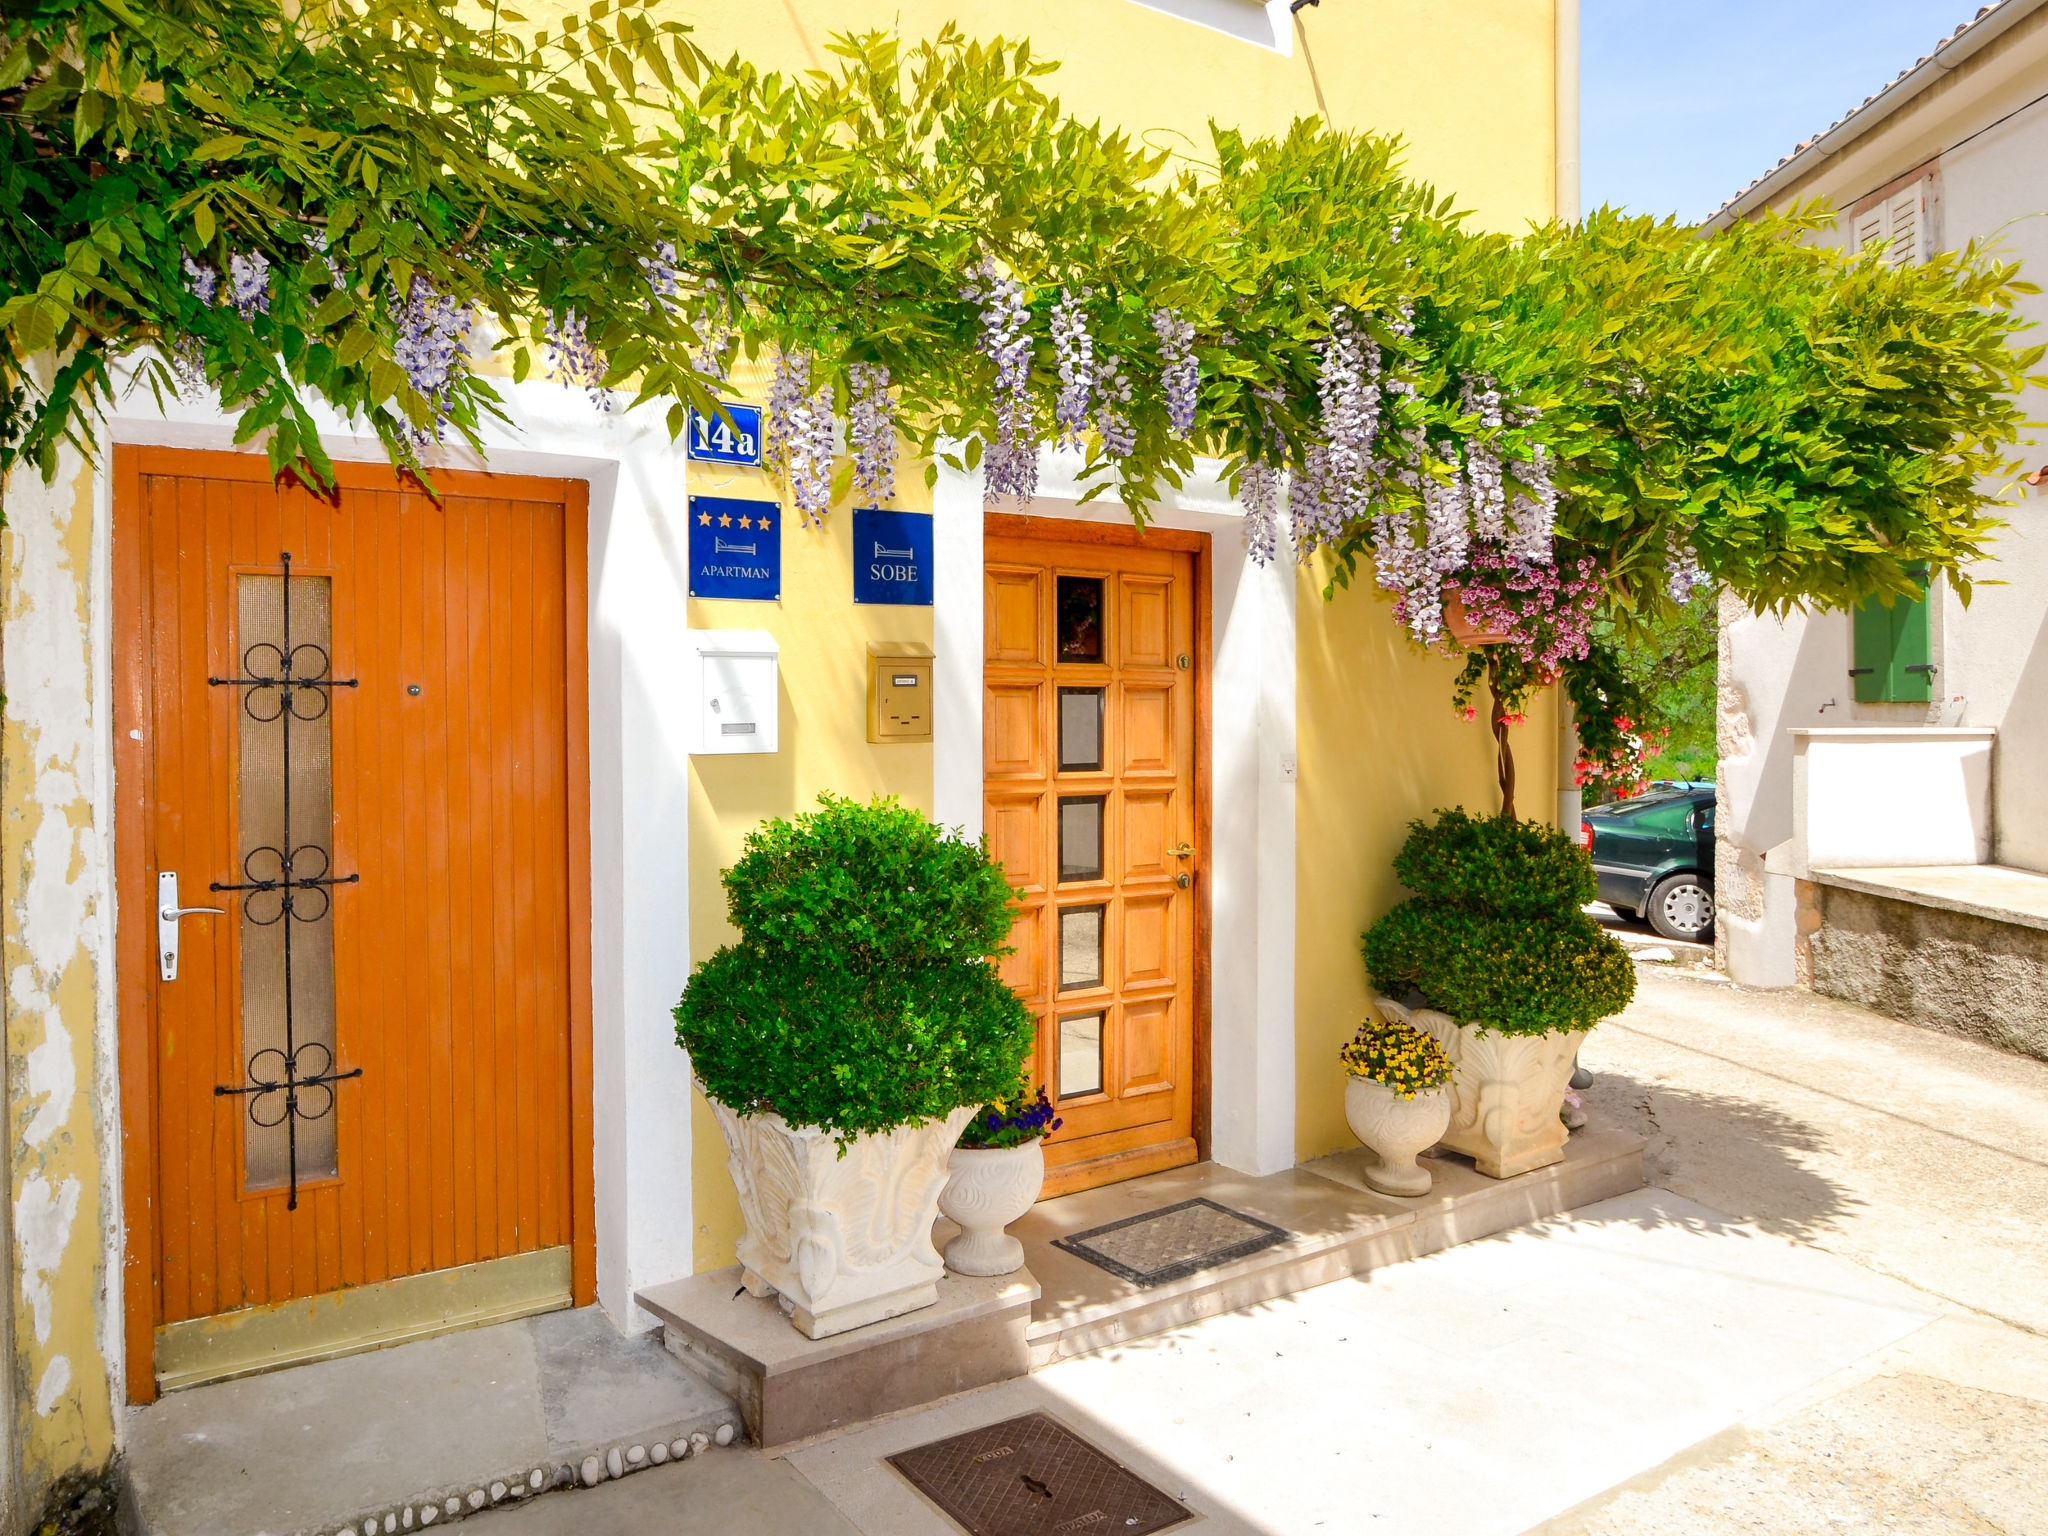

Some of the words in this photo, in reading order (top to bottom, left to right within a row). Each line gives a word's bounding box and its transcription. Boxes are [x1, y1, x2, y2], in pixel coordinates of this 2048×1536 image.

[694, 415, 757, 457] 14a
[700, 564, 770, 579] APARTMAN
[870, 563, 918, 582] SOBE
